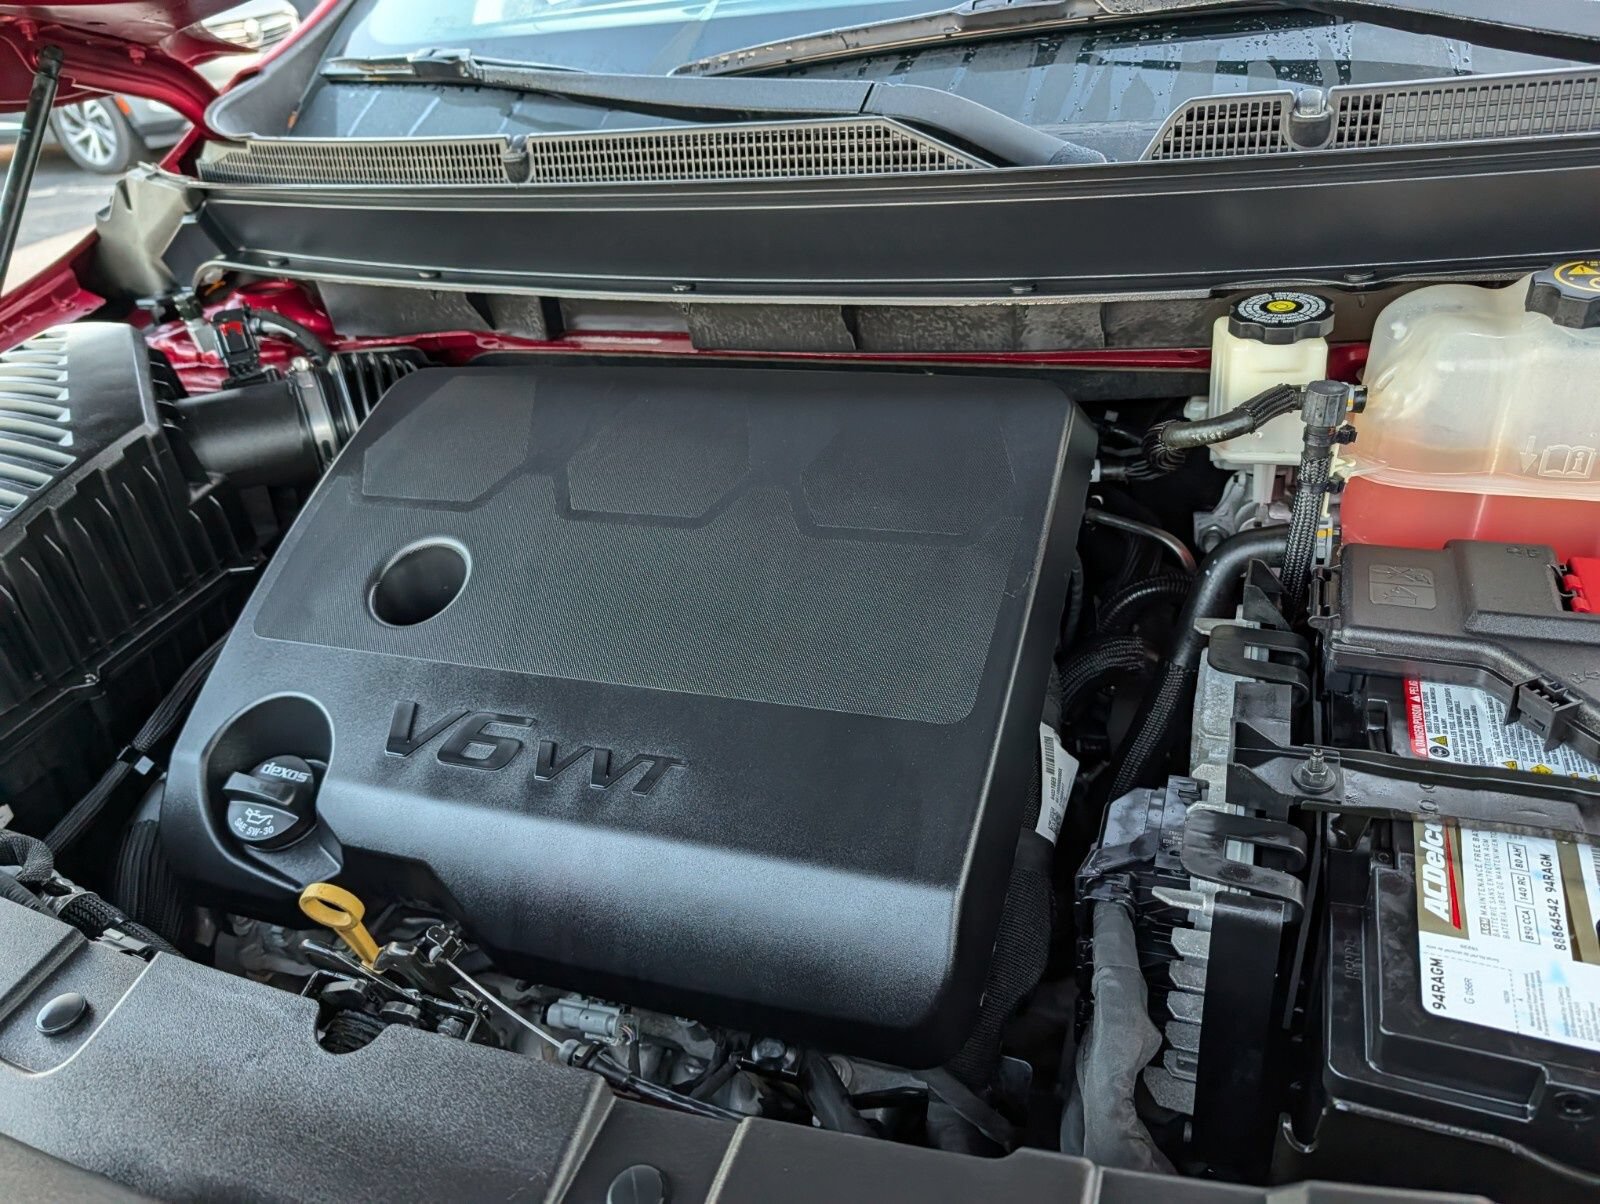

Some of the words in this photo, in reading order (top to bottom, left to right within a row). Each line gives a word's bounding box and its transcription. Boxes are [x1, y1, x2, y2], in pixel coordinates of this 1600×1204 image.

[1412, 703, 1426, 744] DANGER/POISON
[384, 700, 537, 771] V6
[534, 740, 688, 796] VVT
[261, 762, 311, 782] dexos
[235, 817, 247, 832] SAE
[246, 825, 274, 836] 5W-30
[1473, 845, 1481, 861] FREE
[1515, 858, 1523, 869] 80
[1517, 876, 1526, 886] RC
[1539, 854, 1557, 893] 94RAGM
[1474, 863, 1487, 915] MAINTENANCE
[1519, 887, 1528, 901] 140
[1522, 910, 1531, 923] CCA
[1547, 898, 1567, 951] 88864542
[1525, 924, 1534, 940] 850
[1430, 957, 1446, 1010] 94RAGM
